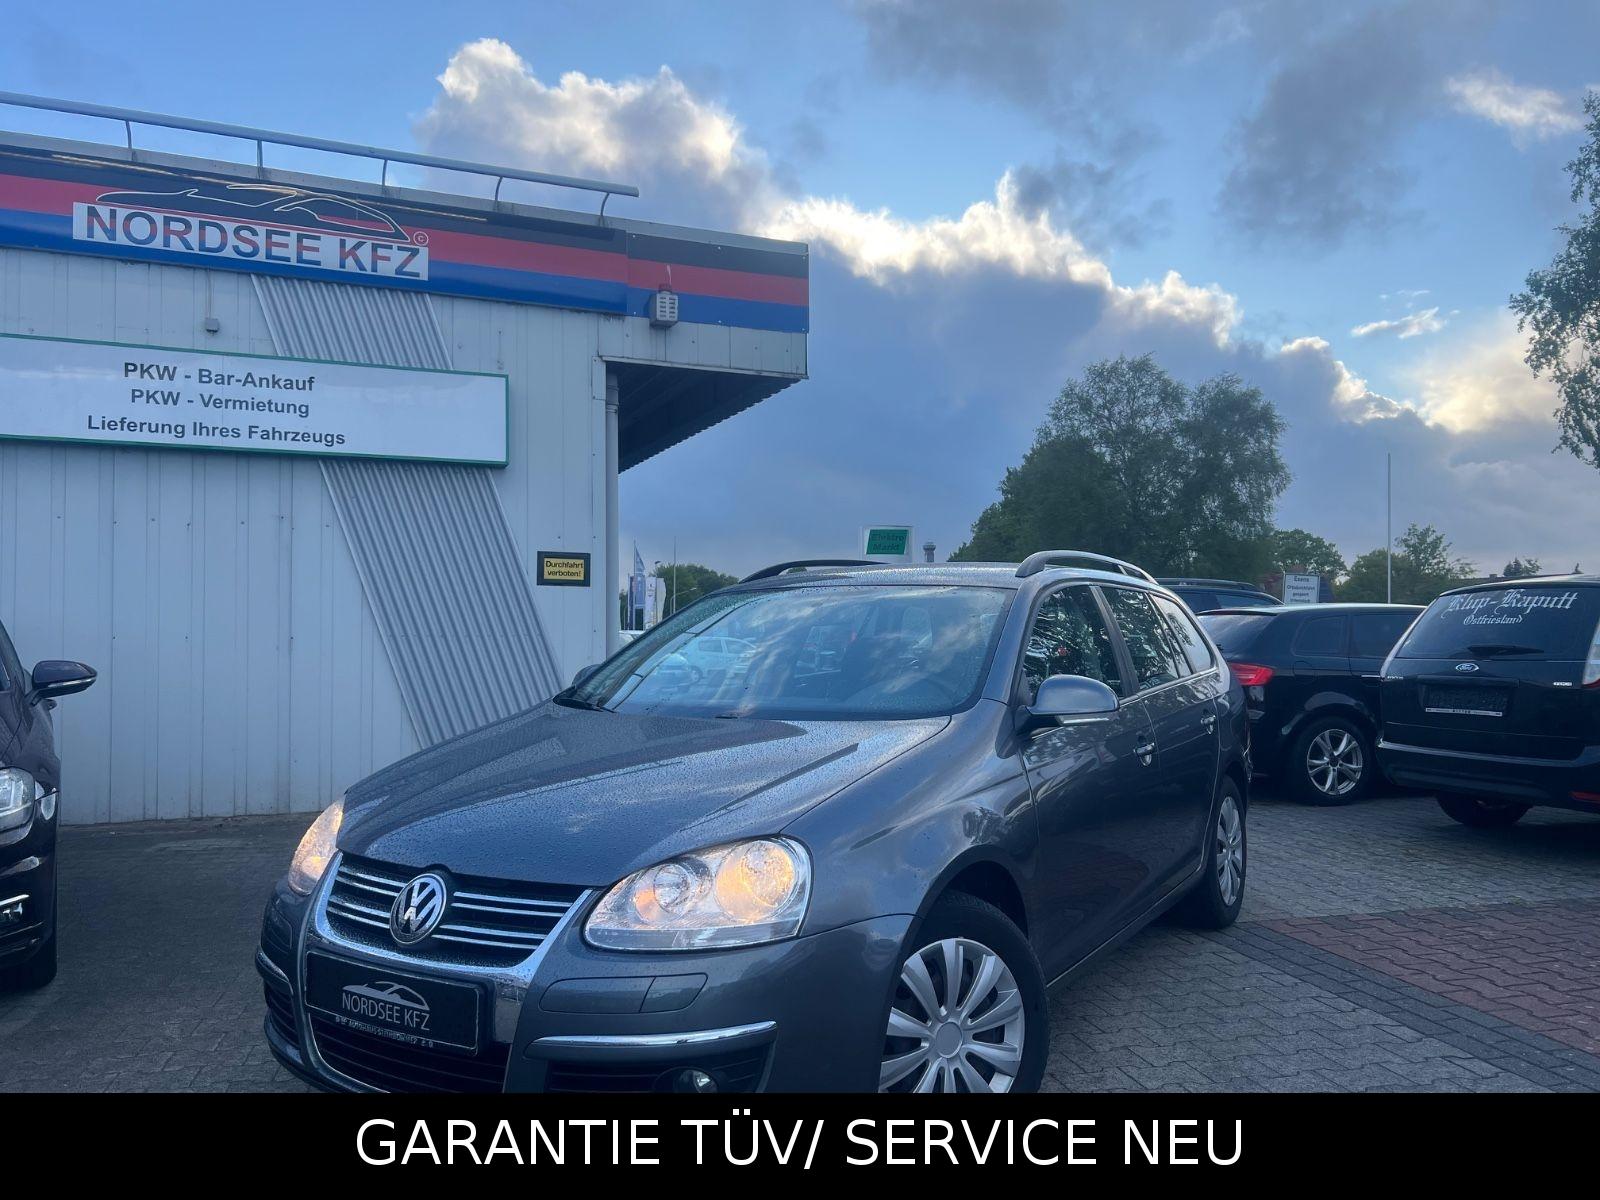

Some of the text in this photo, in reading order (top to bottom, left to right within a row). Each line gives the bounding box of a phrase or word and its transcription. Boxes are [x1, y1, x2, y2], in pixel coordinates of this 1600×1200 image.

[86, 205, 421, 278] NORDSEE KFZ
[124, 362, 177, 381] PKW
[198, 368, 315, 391] Bar-Ankauf
[131, 389, 181, 406] PKW
[200, 393, 310, 418] Vermietung
[87, 415, 346, 447] Lieferung Ihres Fahrzeugs
[545, 560, 584, 569] Durchfahrt
[1463, 614, 1523, 625] Ostfriesland
[342, 992, 430, 1031] NORDSEE KFZ
